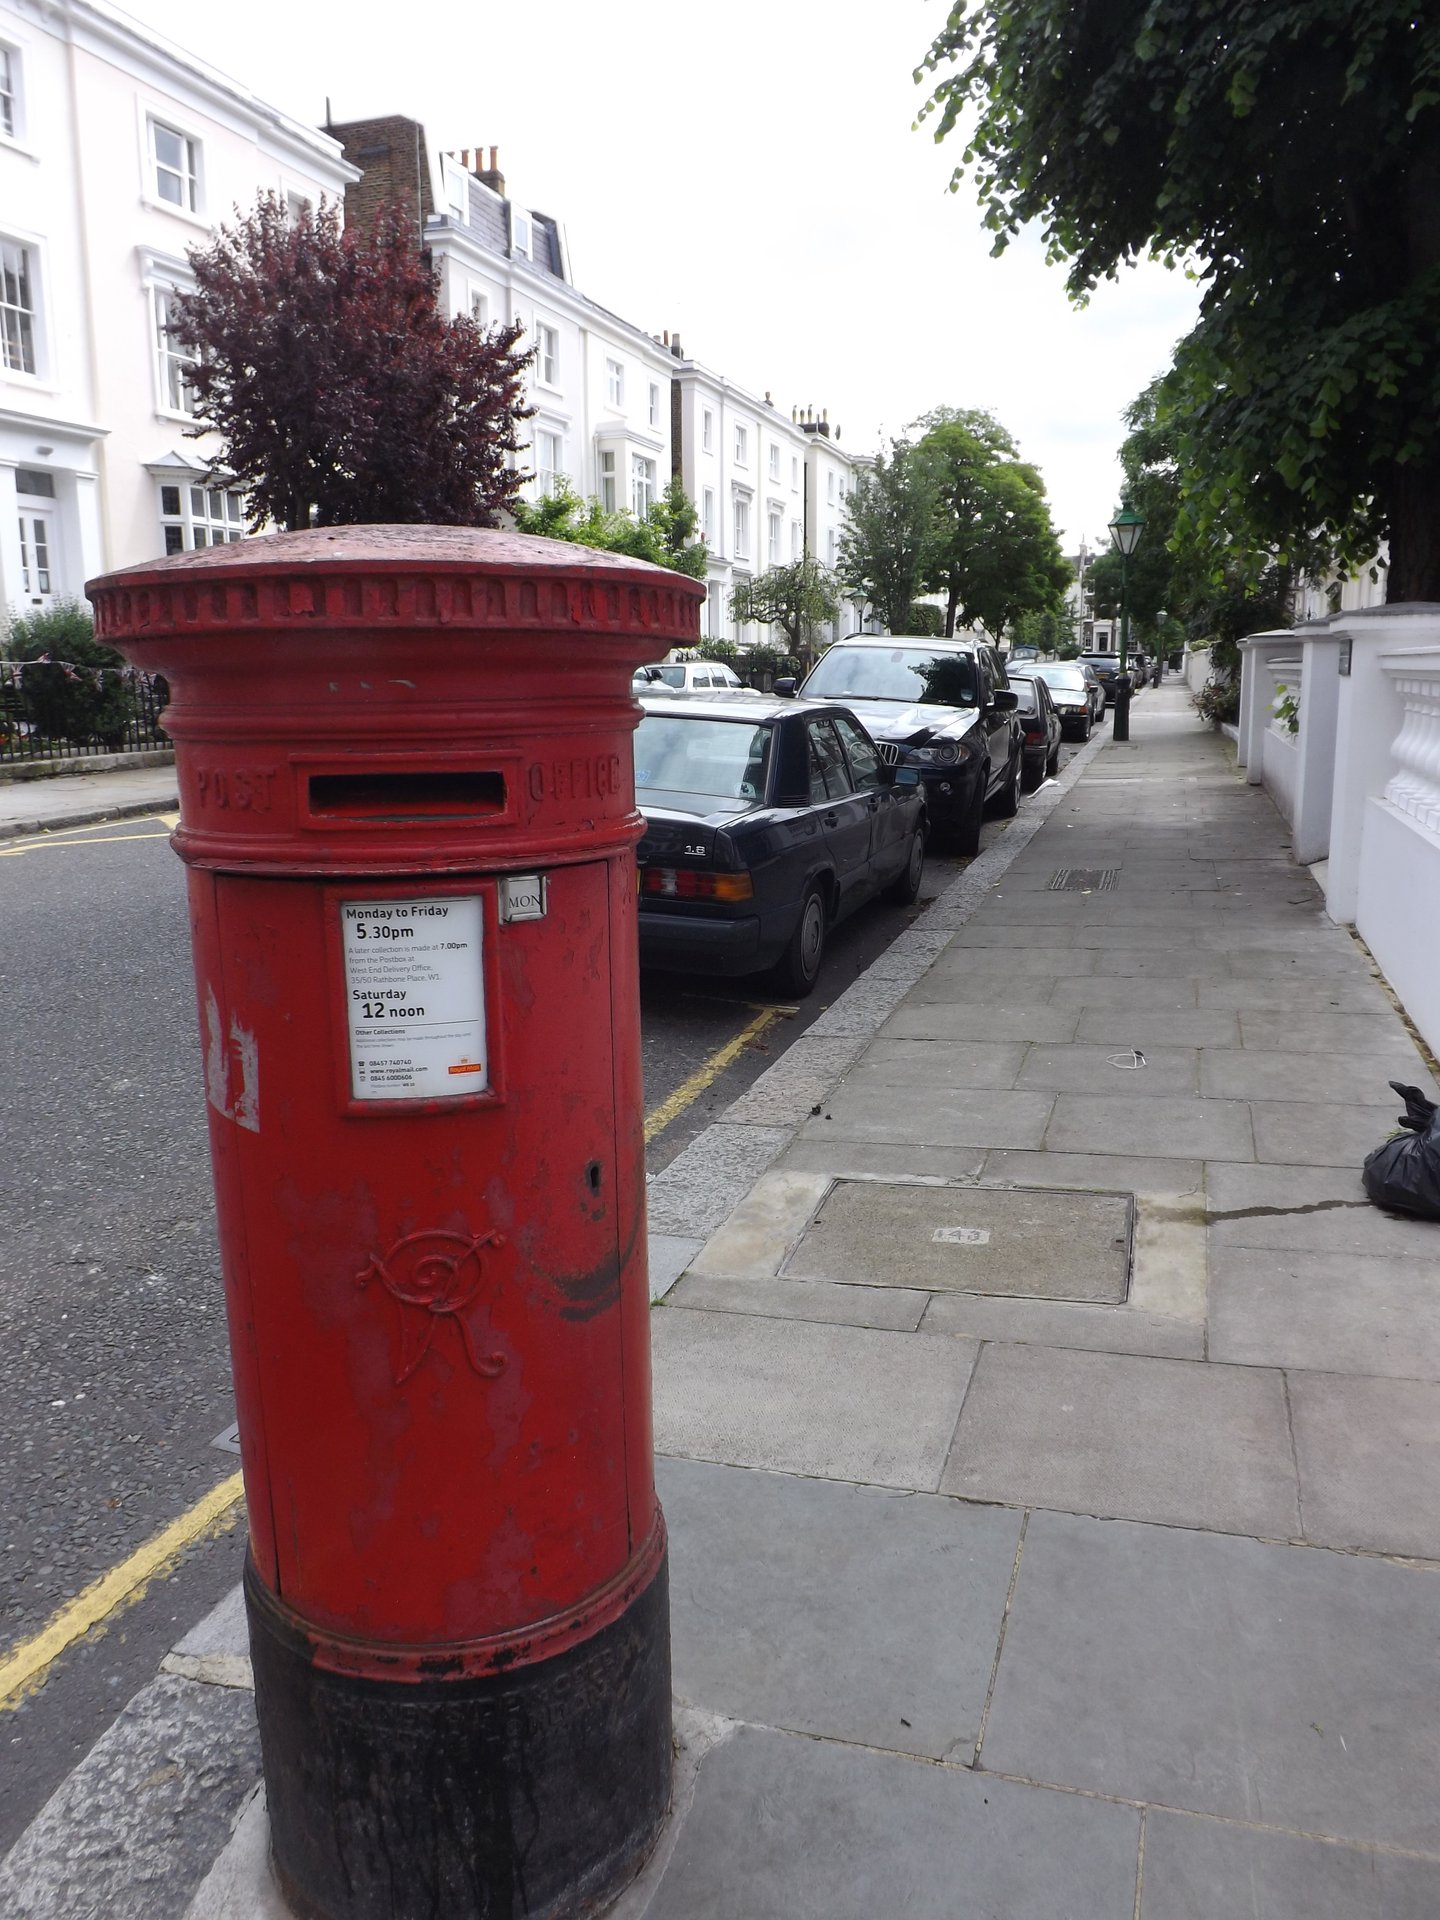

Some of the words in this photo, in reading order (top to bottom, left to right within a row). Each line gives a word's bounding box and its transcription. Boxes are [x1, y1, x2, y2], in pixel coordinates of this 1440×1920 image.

[528, 753, 620, 801] OFFICE
[196, 766, 276, 812] POST
[508, 894, 541, 909] MON
[346, 909, 393, 920] Monday
[396, 908, 408, 917] to
[411, 906, 449, 917] Friday
[356, 923, 414, 940] 5.30pm
[440, 942, 468, 950] 7.00pm
[383, 965, 410, 974] Delivery
[351, 976, 372, 984] 35/50
[373, 975, 405, 983] Rathbone
[352, 989, 407, 1000] Saturday
[362, 1002, 385, 1018] 12
[389, 1007, 425, 1017] noon
[370, 1066, 428, 1074] www.royalmail.com
